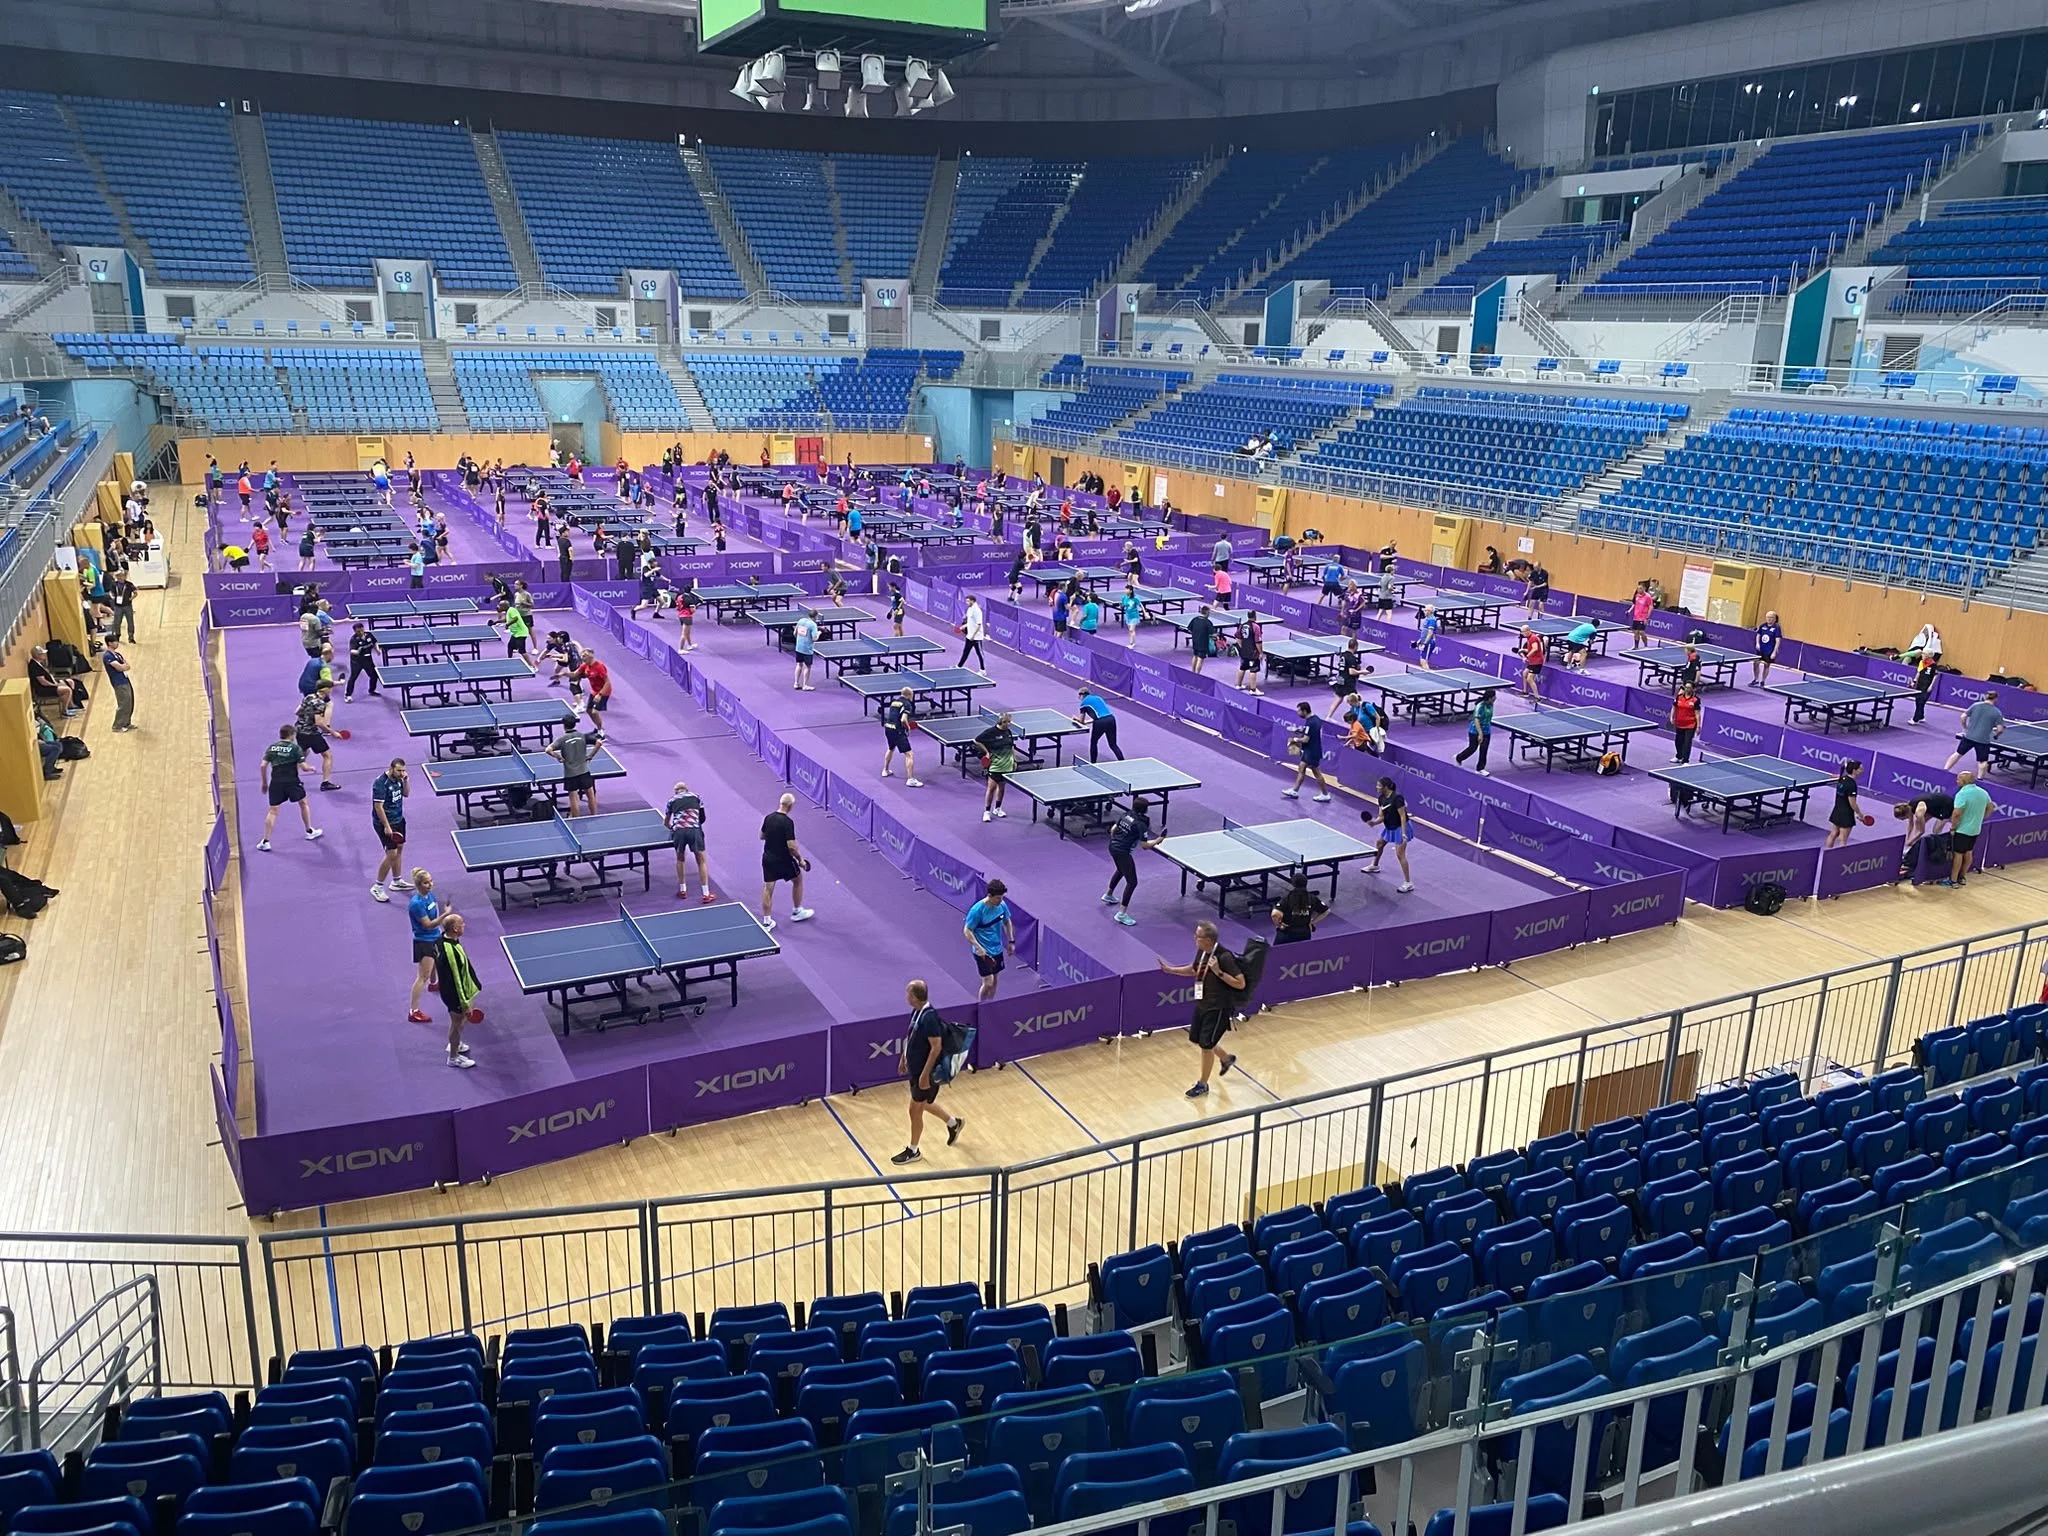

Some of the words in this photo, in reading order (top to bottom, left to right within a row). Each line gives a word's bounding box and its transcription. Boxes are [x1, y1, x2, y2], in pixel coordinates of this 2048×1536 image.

[89, 259, 108, 273] G7
[394, 271, 412, 283] G8
[641, 280, 657, 291] G9
[877, 288, 897, 299] G10
[531, 591, 557, 600] OM
[1547, 598, 1563, 607] OM
[1992, 801, 2037, 818] XIO
[1057, 956, 1090, 983] XIO
[1157, 987, 1195, 1007] XI
[869, 1038, 906, 1059] XI
